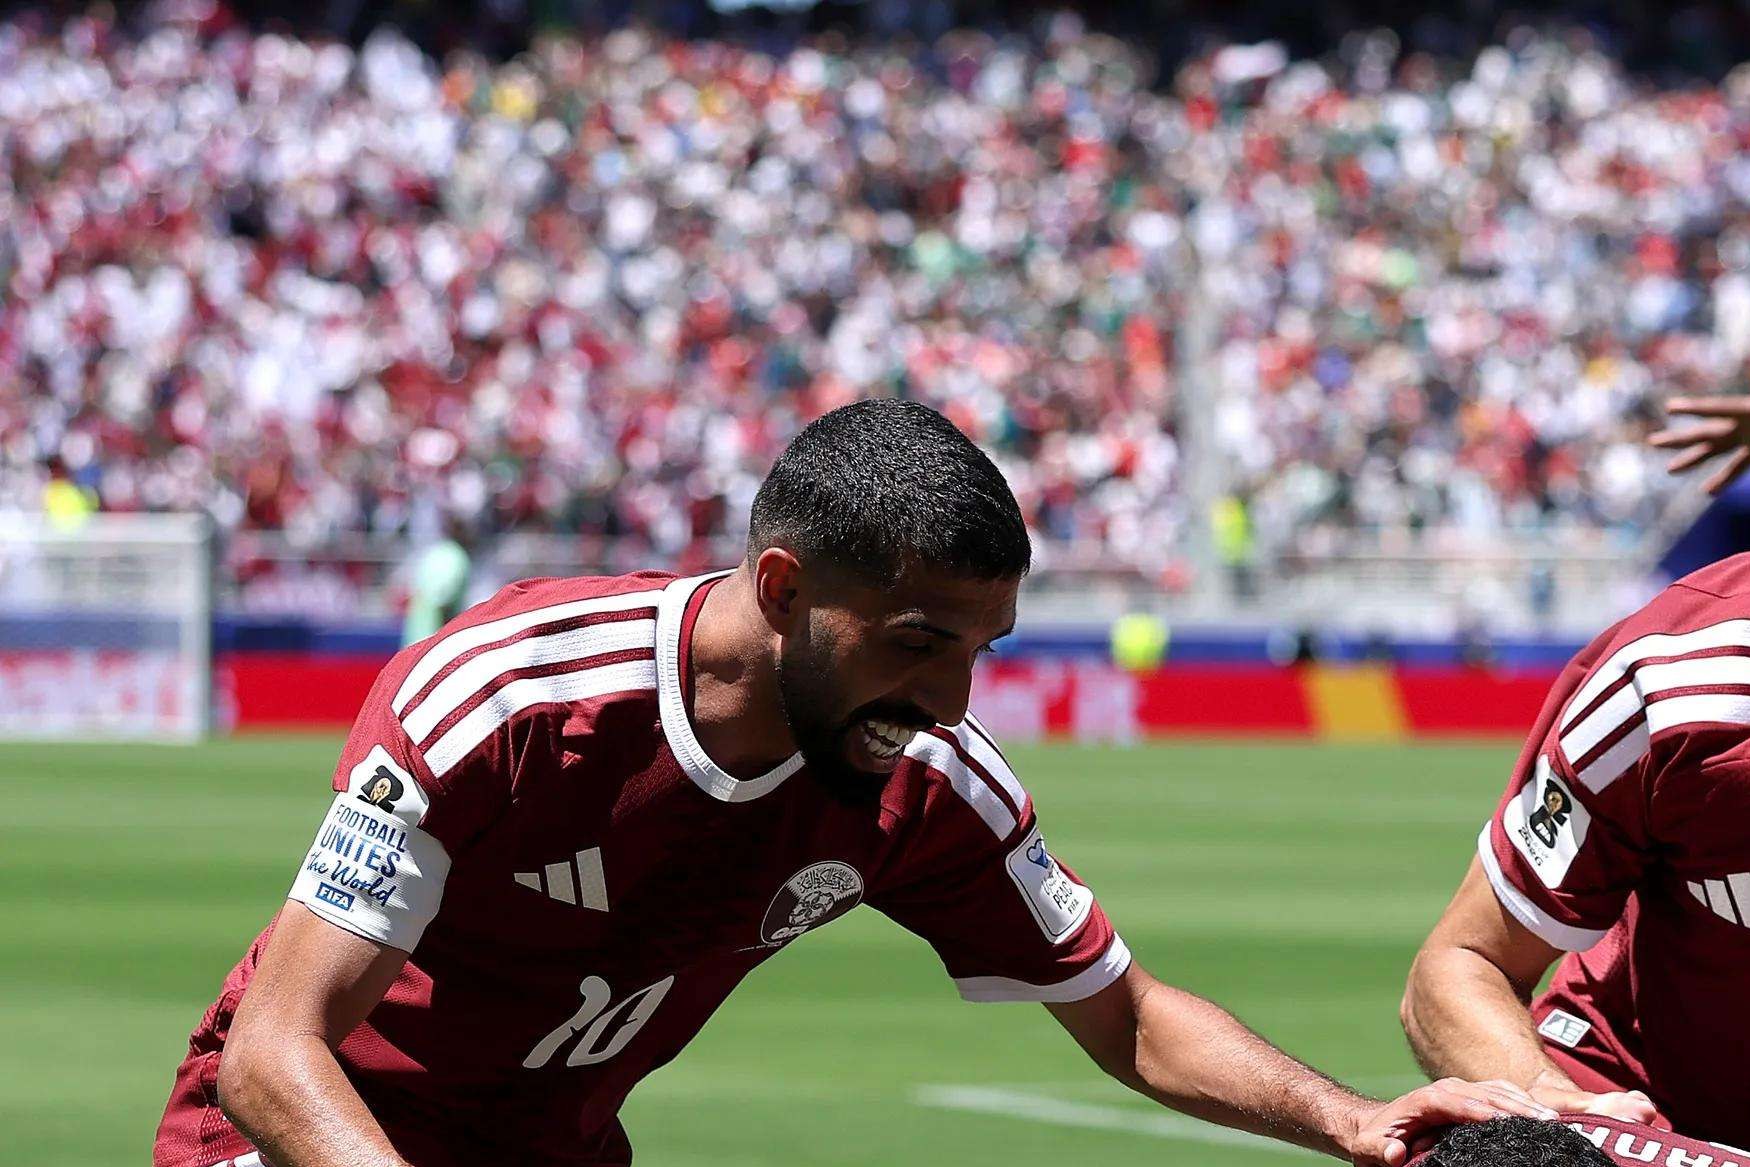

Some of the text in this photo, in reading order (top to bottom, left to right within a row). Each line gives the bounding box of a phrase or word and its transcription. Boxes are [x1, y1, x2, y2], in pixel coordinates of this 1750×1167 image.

[319, 823, 401, 879] UNITES
[335, 803, 407, 854] FOOTBALL
[306, 850, 397, 908] the World
[319, 886, 353, 910] FIFA
[1052, 880, 1073, 910] PEAC
